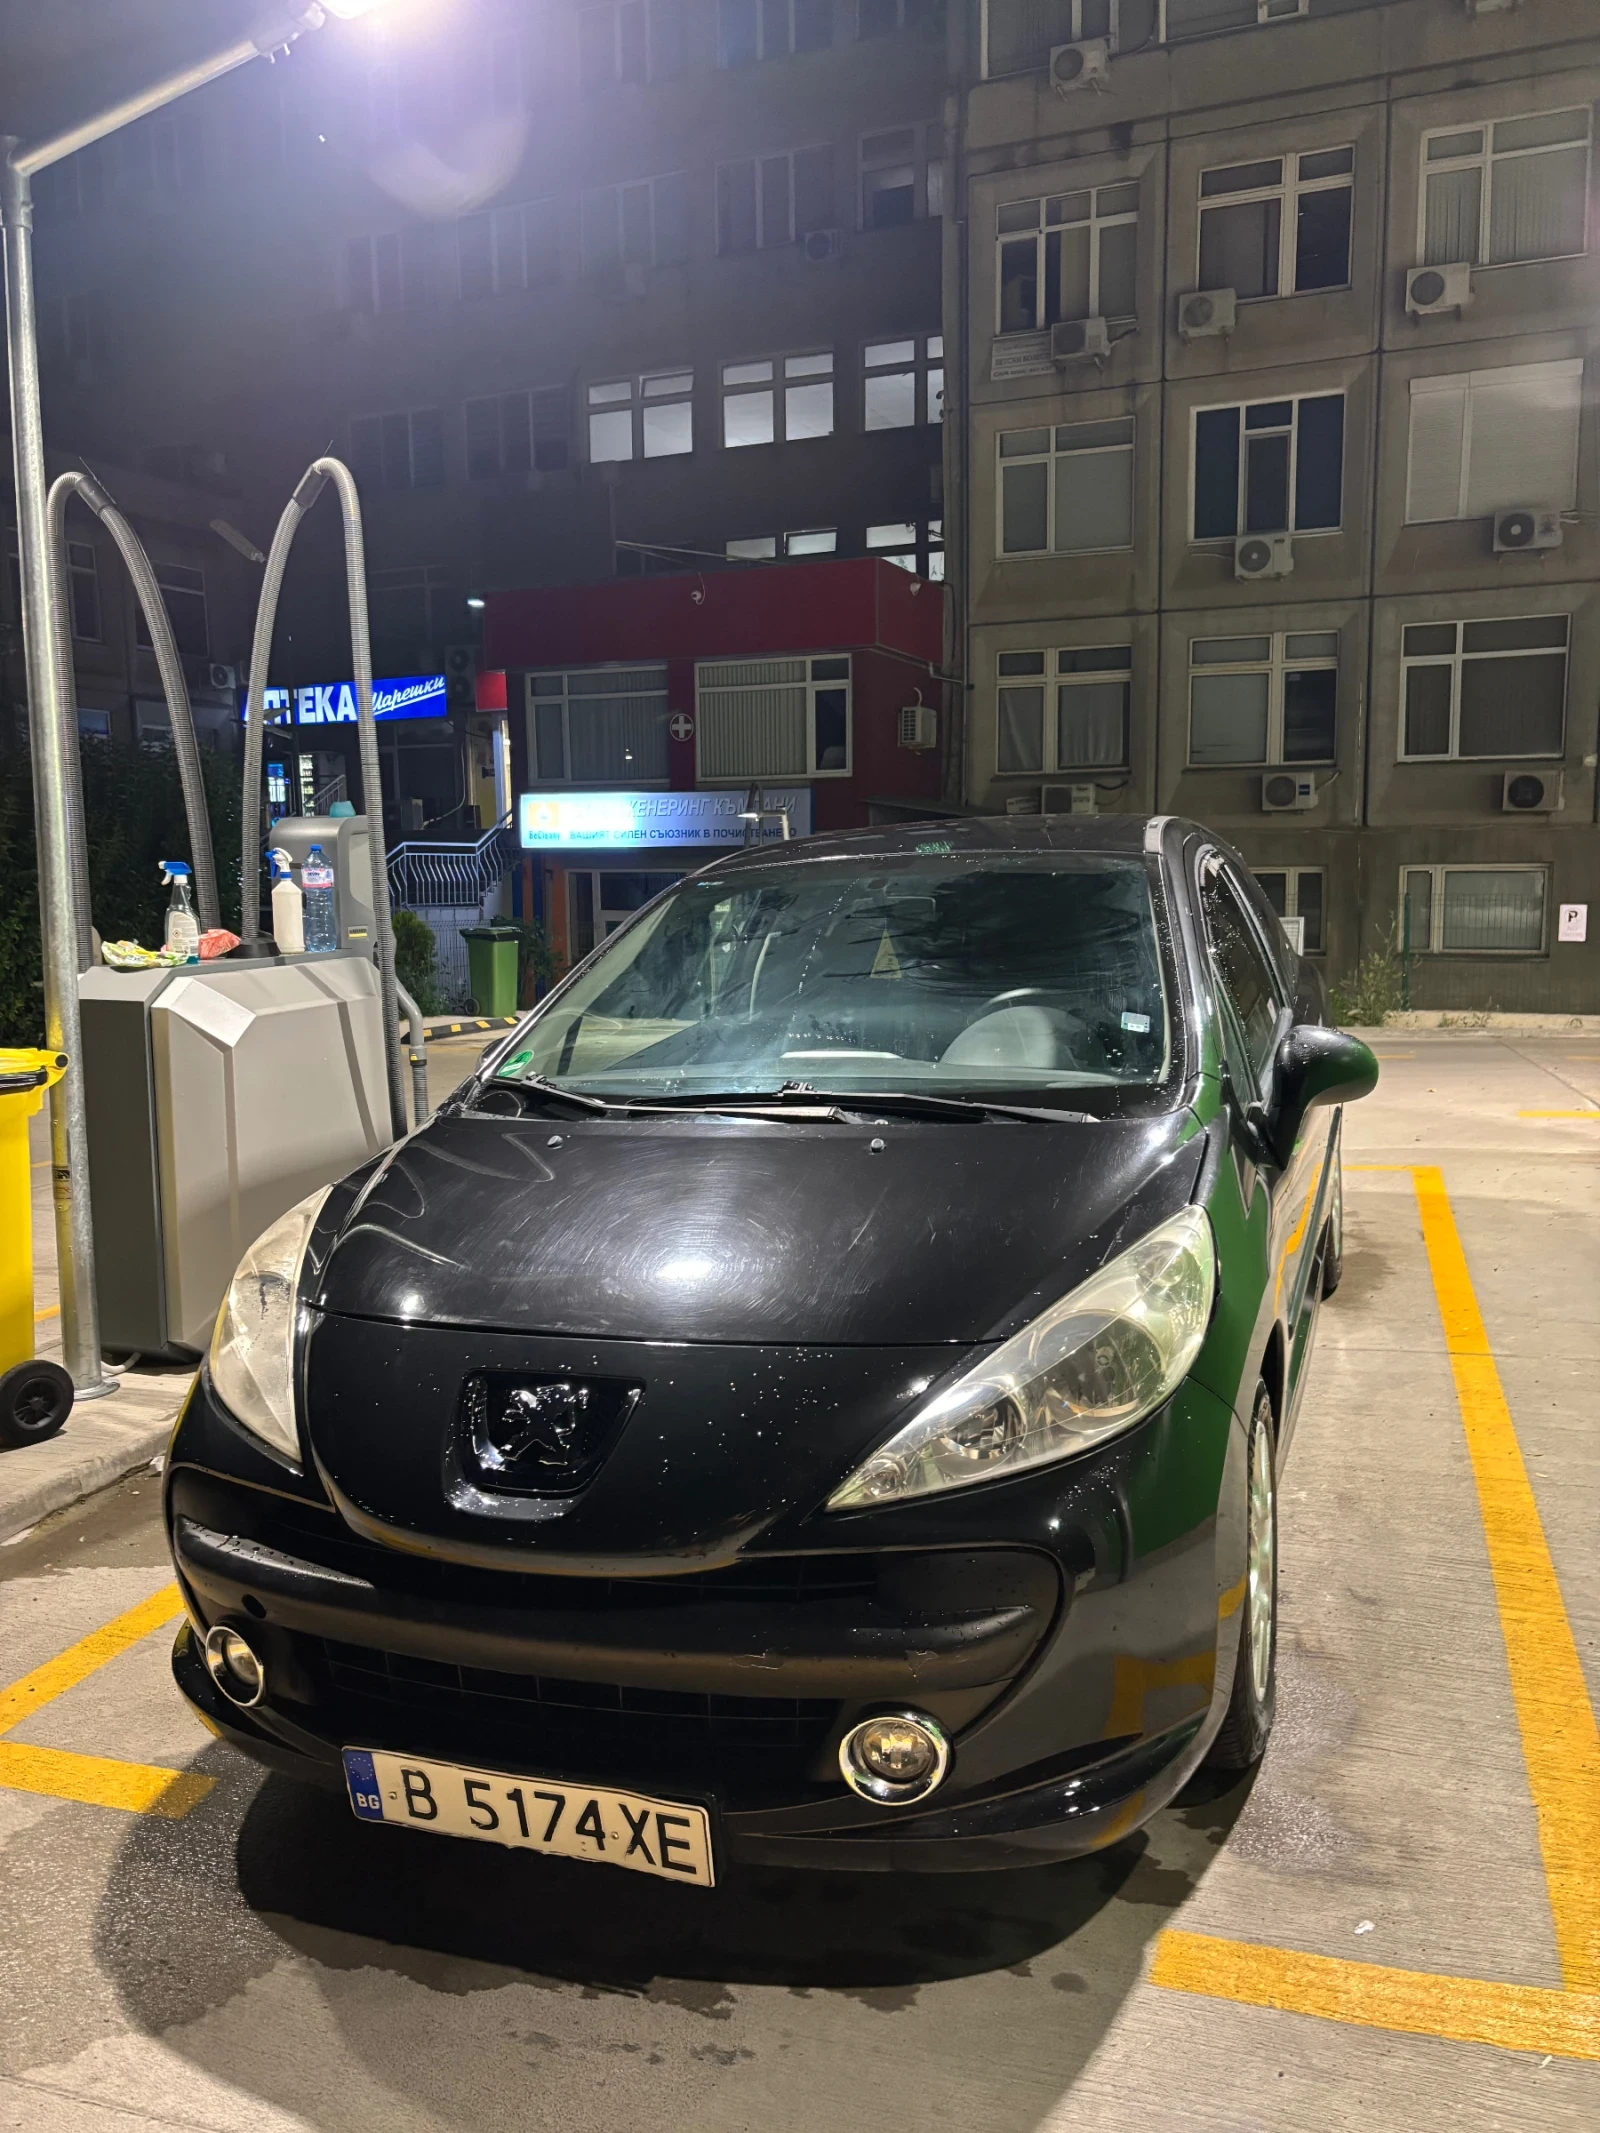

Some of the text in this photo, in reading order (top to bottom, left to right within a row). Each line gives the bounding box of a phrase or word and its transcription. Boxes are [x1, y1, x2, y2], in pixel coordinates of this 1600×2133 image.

[244, 685, 358, 725] ПТЕКА
[569, 830, 610, 840] ВАШИЯТ
[613, 829, 647, 839] СИЛЕН
[650, 829, 701, 838] СЪЮЗНИК
[703, 829, 711, 838] В
[1568, 910, 1578, 923] P
[356, 1793, 381, 1810] BG
[400, 1767, 697, 1874] B 5174 XE
